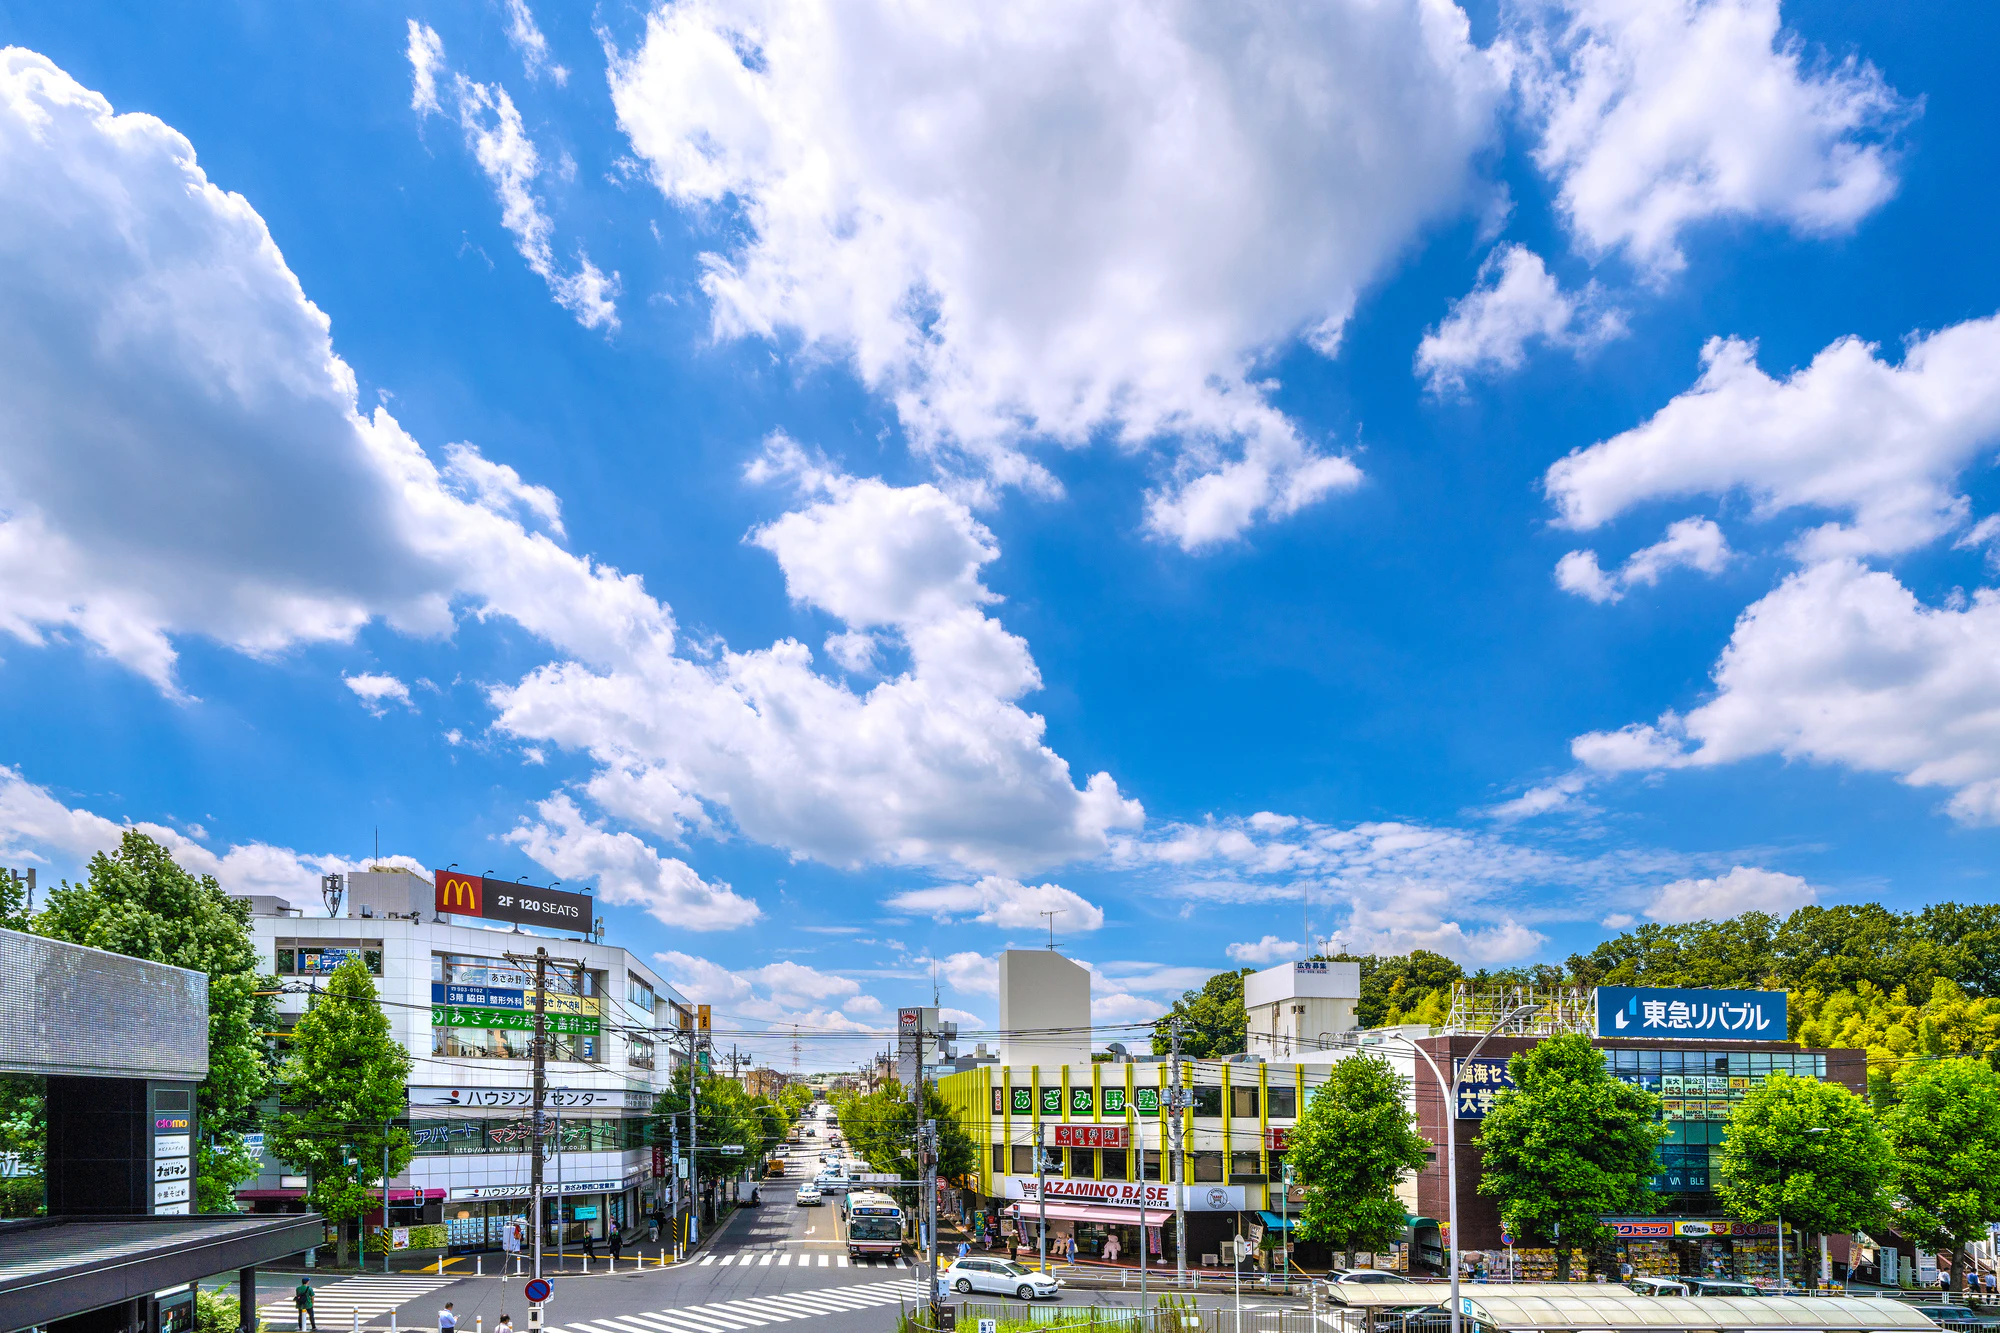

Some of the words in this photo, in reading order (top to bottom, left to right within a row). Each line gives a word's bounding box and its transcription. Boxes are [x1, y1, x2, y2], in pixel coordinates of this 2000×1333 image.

[498, 895, 514, 907] 2F
[519, 898, 541, 911] 120
[542, 902, 579, 918] SEATS
[449, 993, 464, 1002] 3階
[466, 993, 486, 1004] 脇田
[489, 995, 523, 1006] 整形外科
[1642, 1000, 1770, 1031] 東急リバブル
[584, 1021, 598, 1032] 3F
[1014, 1089, 1158, 1110] あざみ野塾
[414, 1122, 480, 1146] アパート
[489, 1121, 556, 1145] マンシン
[563, 1121, 617, 1144] テナント
[564, 1182, 616, 1191] あざみ野西口営業所
[1044, 1181, 1118, 1197] AZAMINO
[1121, 1185, 1168, 1201] BASE
[1107, 1197, 1136, 1205] RETAIL
[1464, 1300, 1471, 1312] 5
